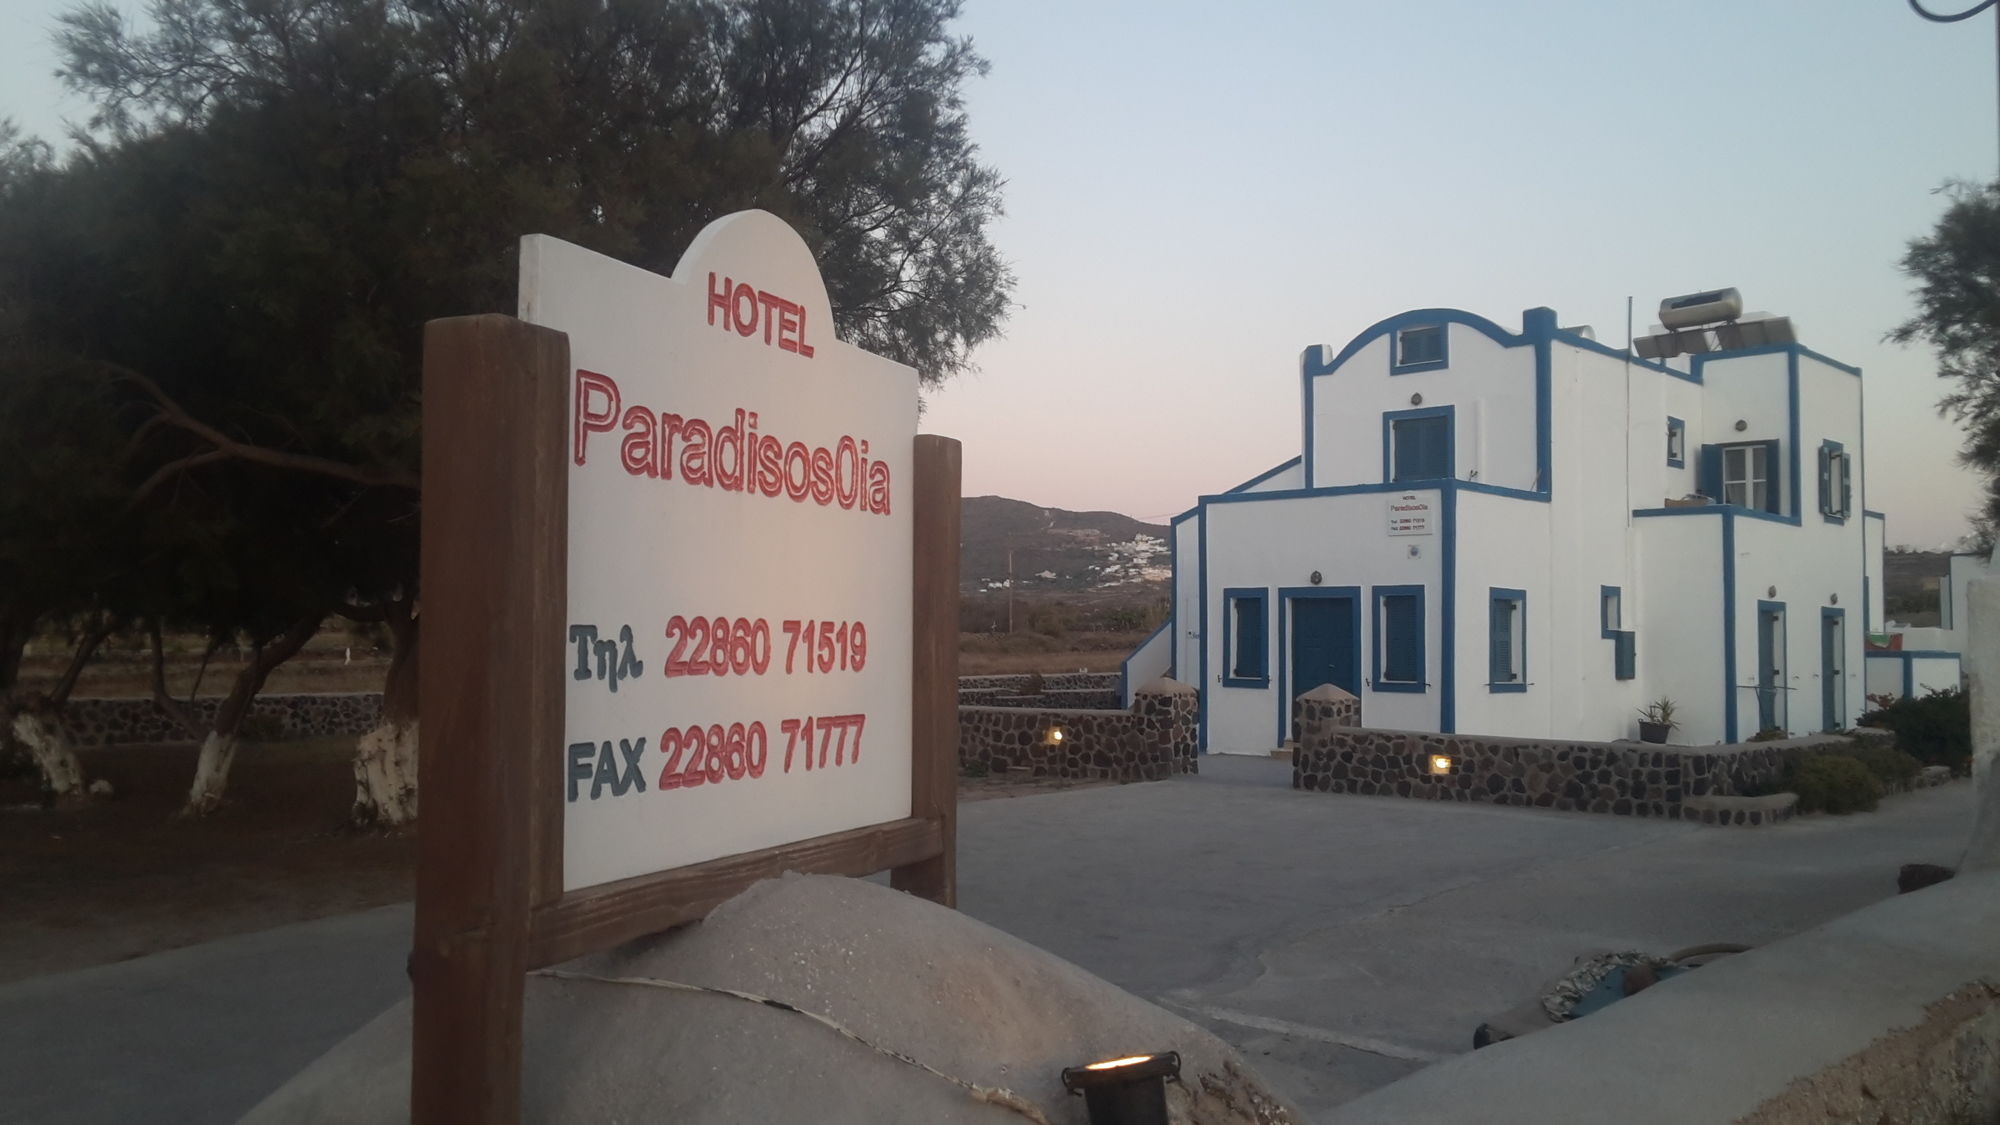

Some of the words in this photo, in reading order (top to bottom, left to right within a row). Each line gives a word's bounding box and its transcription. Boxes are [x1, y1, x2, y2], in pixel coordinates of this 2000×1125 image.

[708, 271, 815, 358] HOTEL
[569, 624, 644, 693] Τηλ
[664, 615, 772, 679] 22860
[782, 619, 867, 675] 71519
[567, 737, 647, 802] FAX
[659, 720, 768, 791] 22860
[781, 713, 866, 773] 71777
